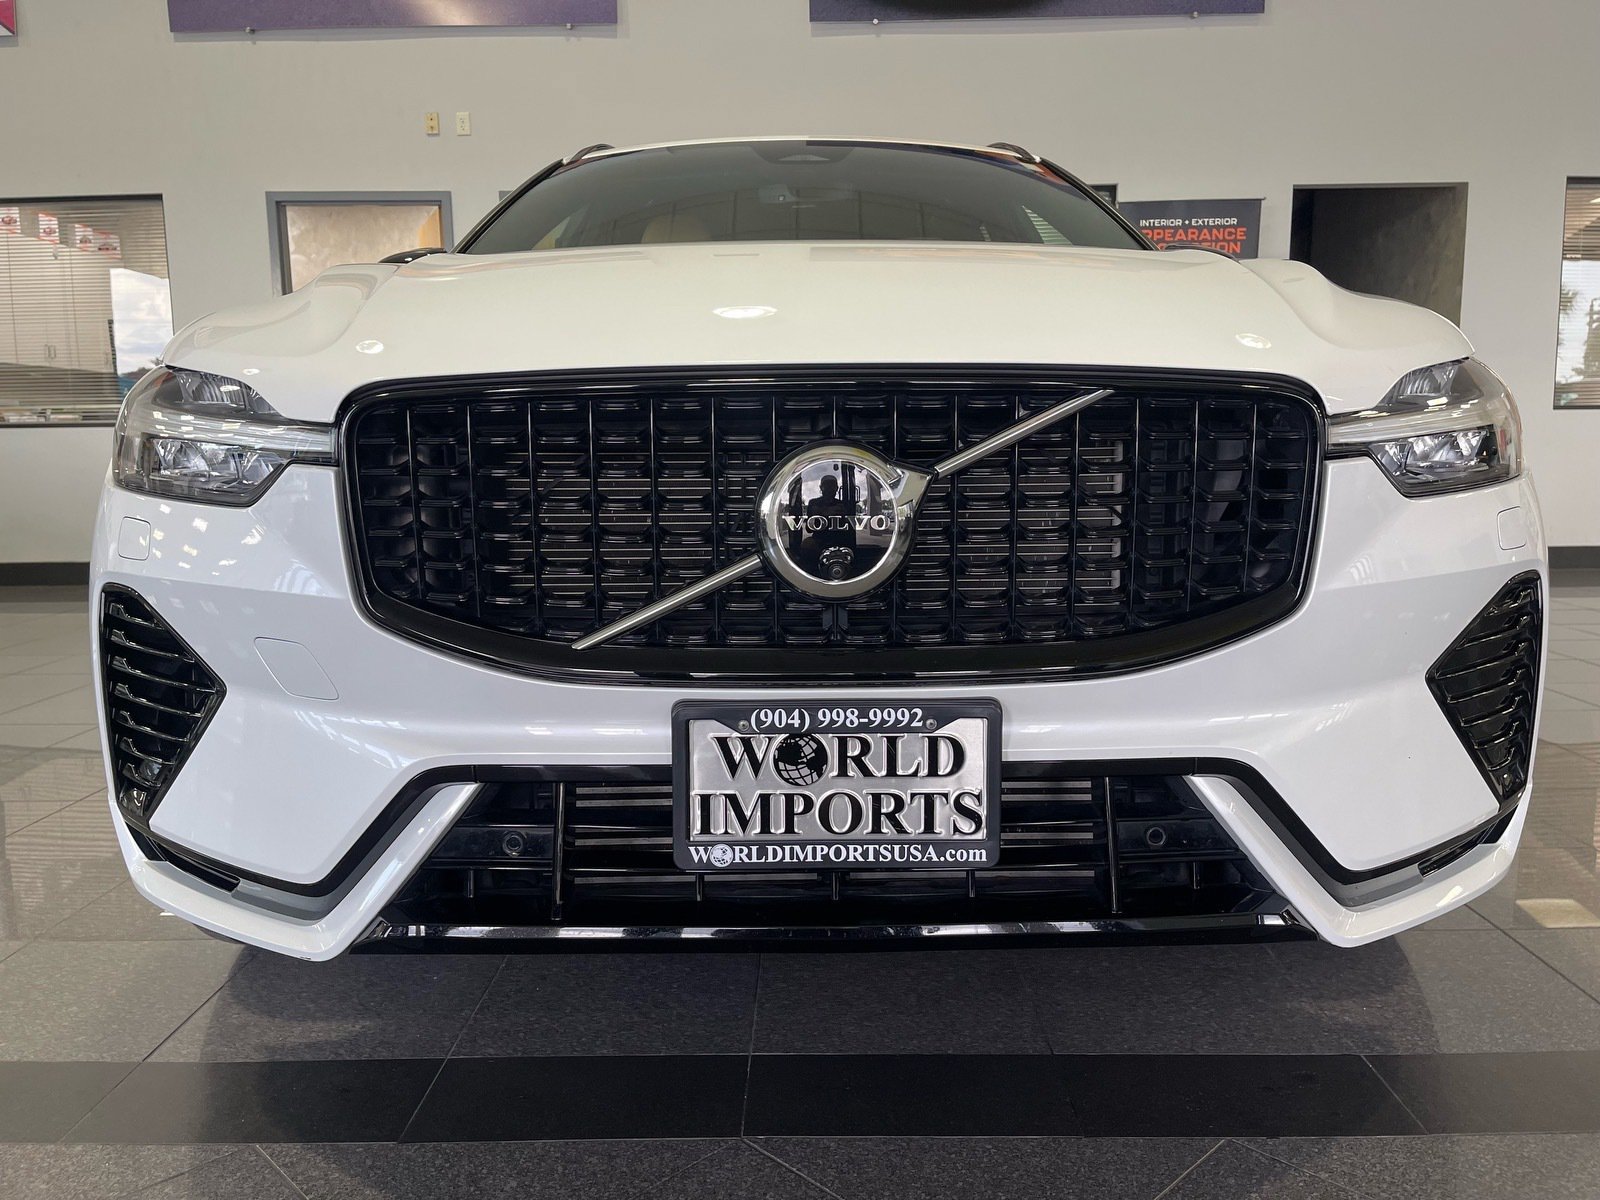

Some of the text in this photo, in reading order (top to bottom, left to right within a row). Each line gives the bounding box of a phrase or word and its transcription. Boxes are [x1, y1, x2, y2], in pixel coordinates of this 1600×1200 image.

[1140, 219, 1182, 227] INTERIOR
[1191, 218, 1238, 226] EXTERIOR
[781, 515, 892, 531] VOLVO
[750, 708, 924, 732] (904) 998-9992
[711, 733, 966, 786] WORLD
[693, 790, 985, 836] IMPORTS
